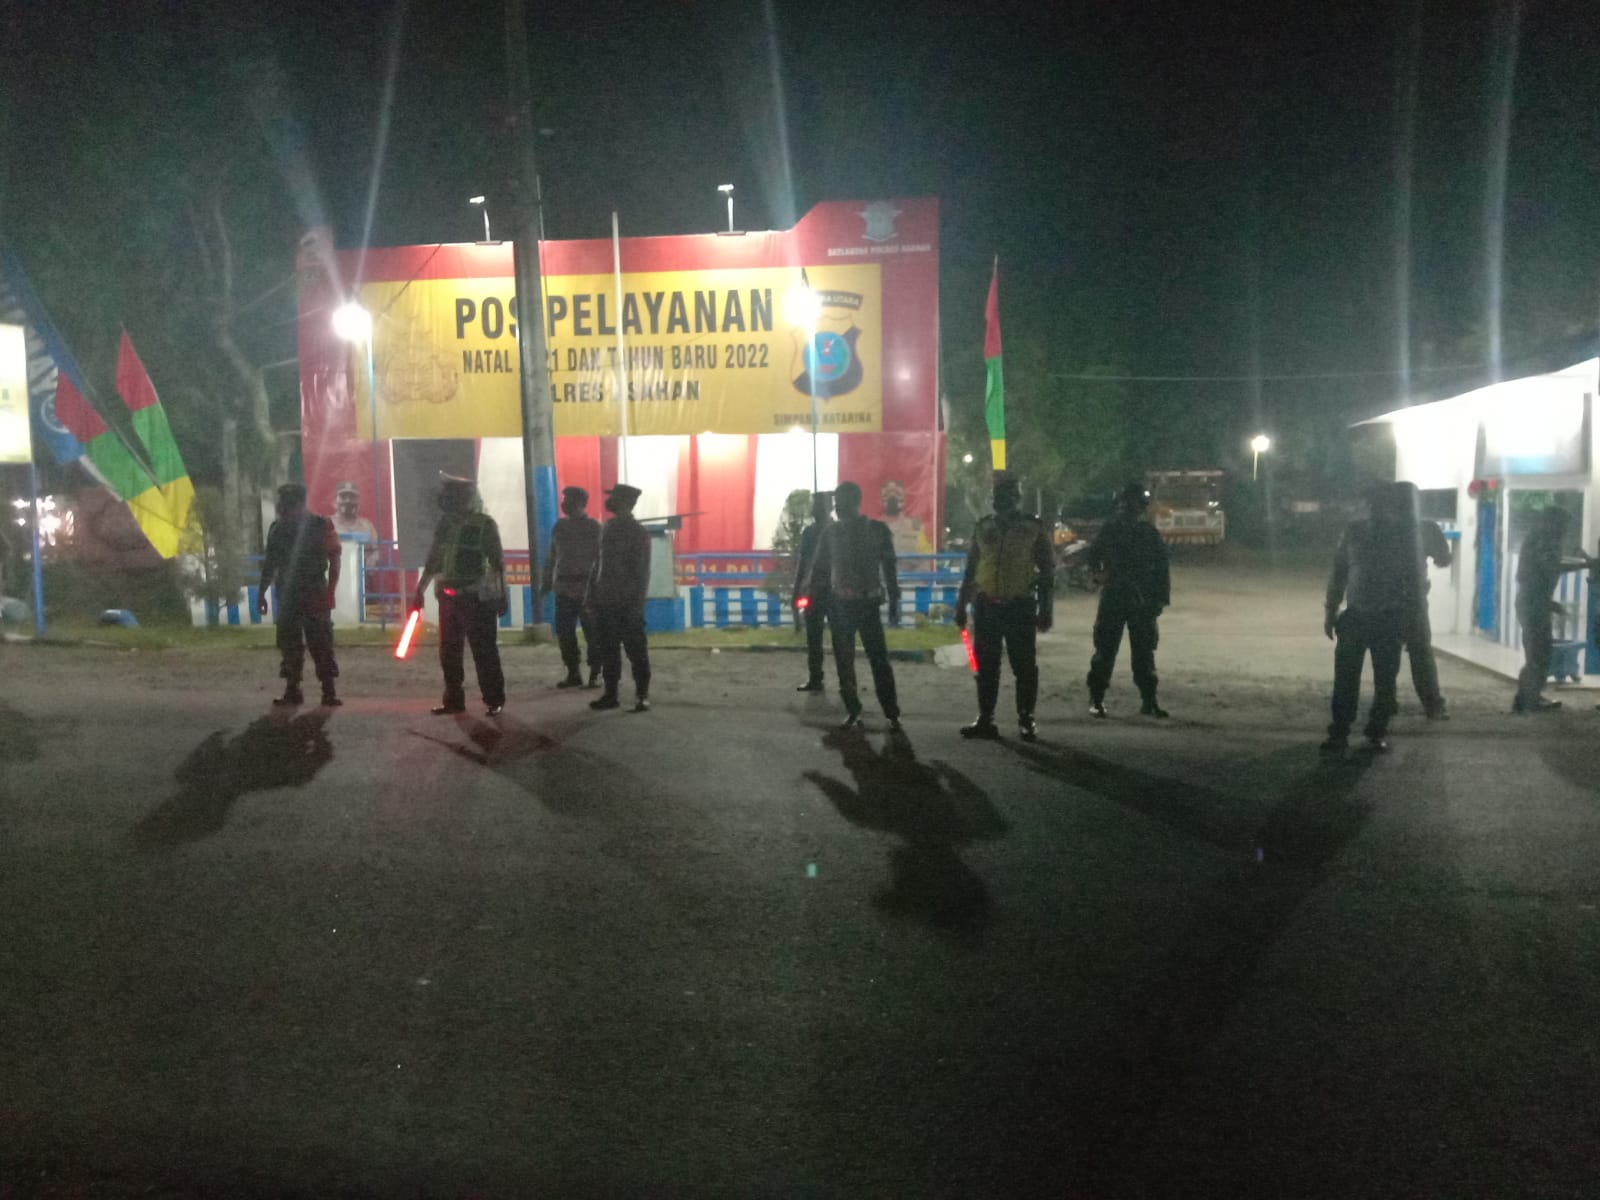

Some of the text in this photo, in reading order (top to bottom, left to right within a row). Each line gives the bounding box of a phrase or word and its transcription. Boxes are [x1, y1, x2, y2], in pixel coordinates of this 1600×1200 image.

[549, 288, 773, 337] PELAYANAN
[463, 350, 512, 373] NATAL
[567, 347, 600, 371] DAN
[607, 346, 663, 371] THUN
[672, 344, 717, 369] BARU
[726, 343, 768, 368] 2022
[550, 381, 699, 402] LRES SAHAN
